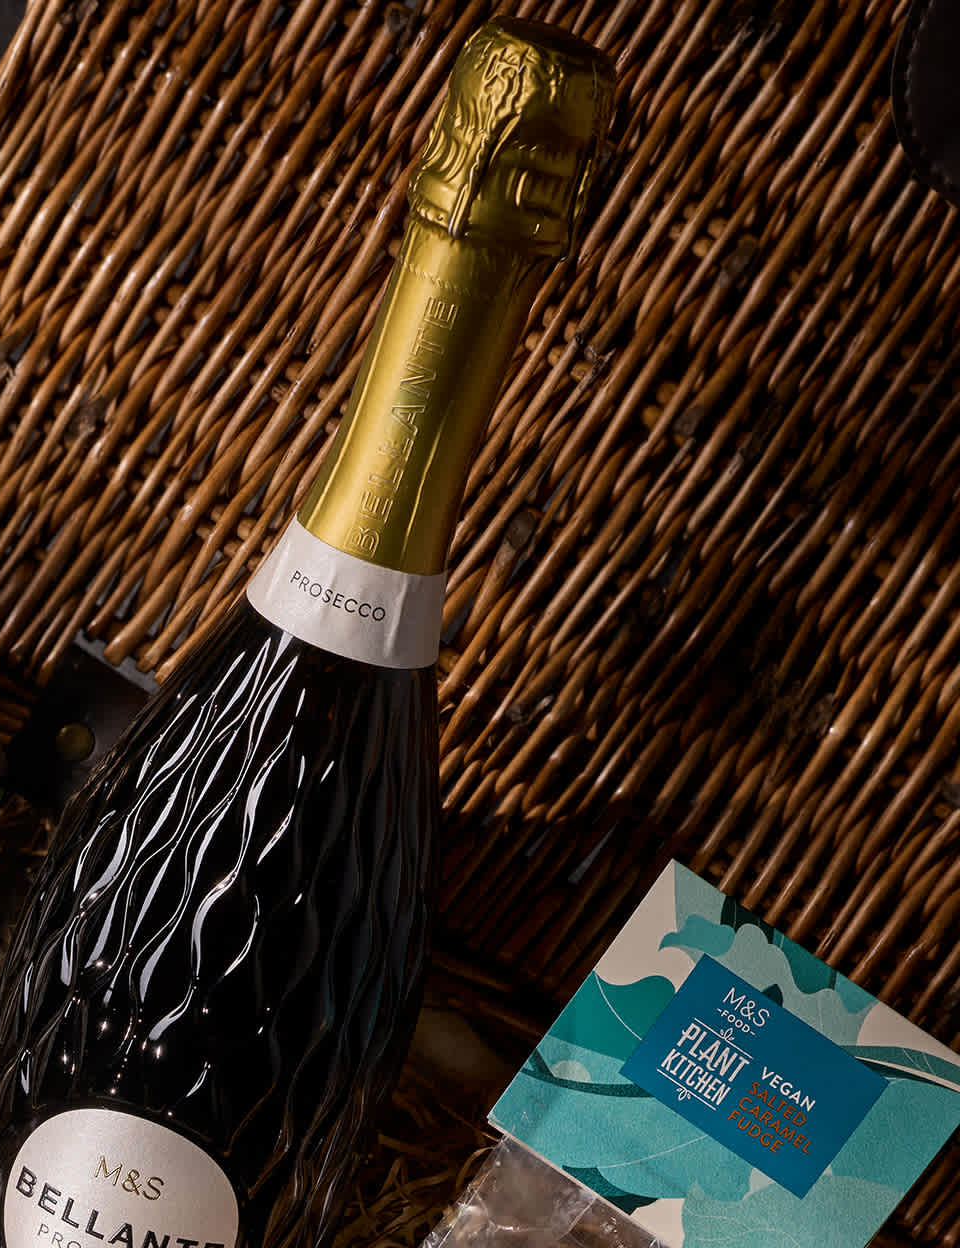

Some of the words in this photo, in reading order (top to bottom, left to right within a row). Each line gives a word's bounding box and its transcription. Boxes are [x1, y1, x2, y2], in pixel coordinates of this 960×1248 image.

[343, 295, 459, 558] BELLANTE
[290, 570, 387, 623] PROSECCO
[722, 987, 770, 1027] M&S
[660, 1048, 731, 1106] KITCHEN
[676, 1022, 750, 1083] PLANT
[748, 1081, 807, 1127] SALTED
[760, 1066, 816, 1112] VEGAN
[727, 1110, 784, 1153] FUDGE
[738, 1097, 813, 1154] CARAMEL
[94, 1155, 165, 1201] M&S
